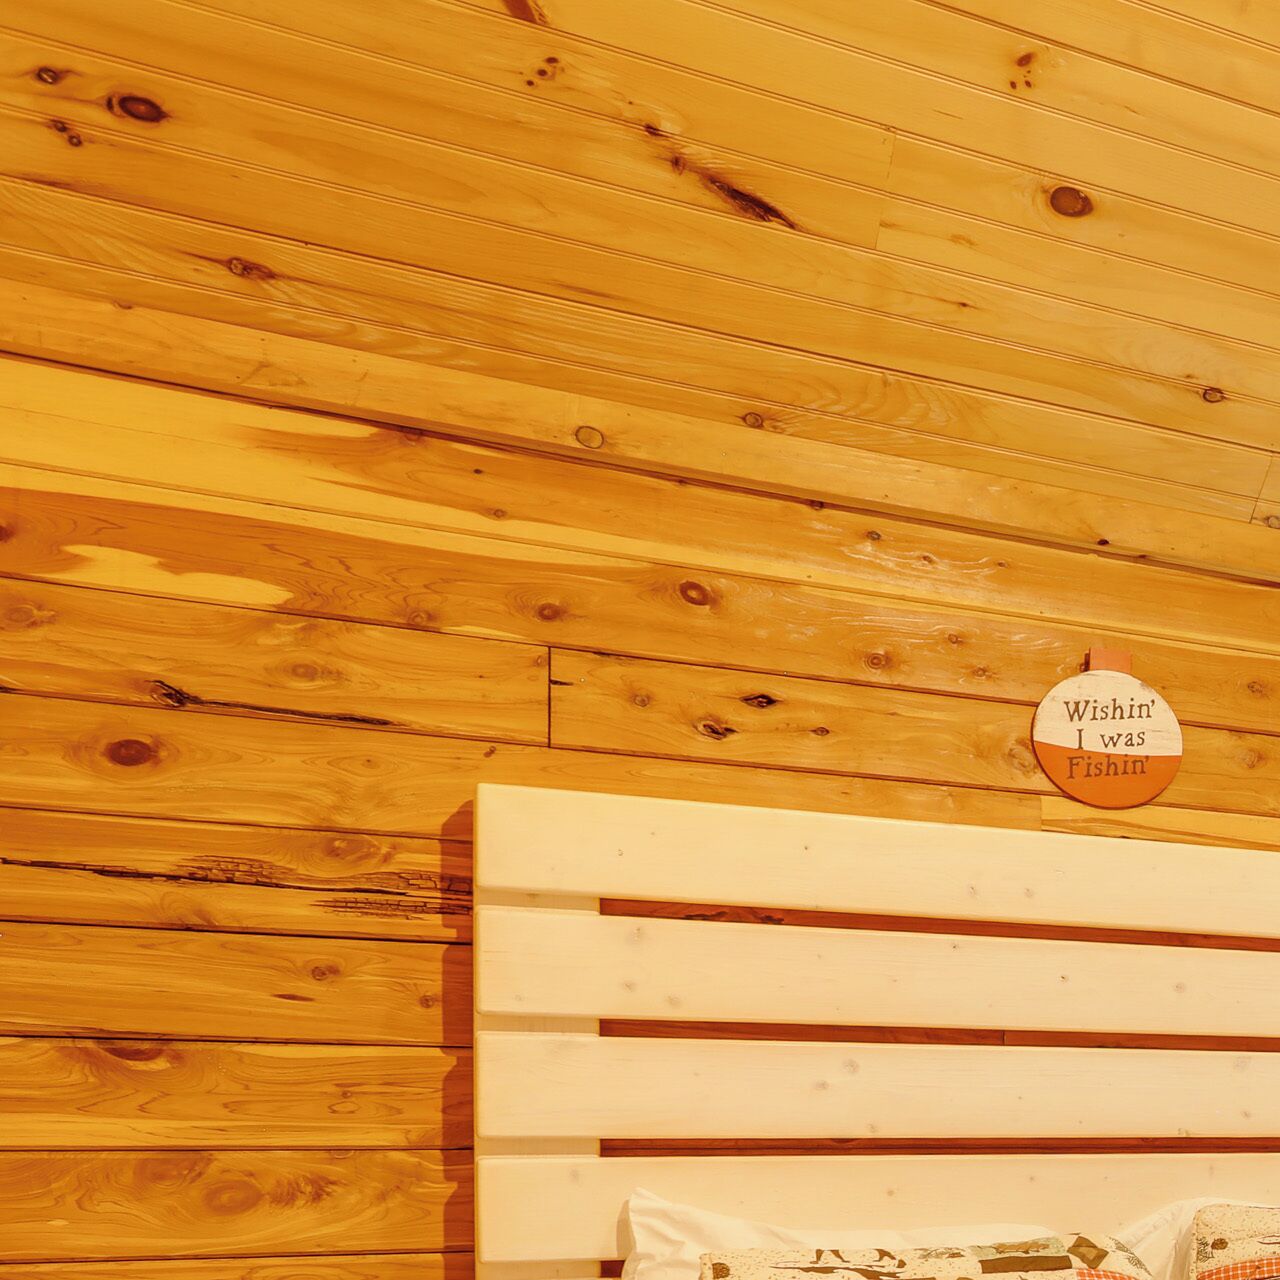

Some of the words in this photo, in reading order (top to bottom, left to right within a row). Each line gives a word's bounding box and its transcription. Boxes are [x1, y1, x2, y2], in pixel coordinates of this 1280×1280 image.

[1063, 697, 1156, 723] Wishin'
[1076, 727, 1085, 750] I
[1099, 730, 1146, 749] was
[1066, 753, 1150, 780] Fishin'
